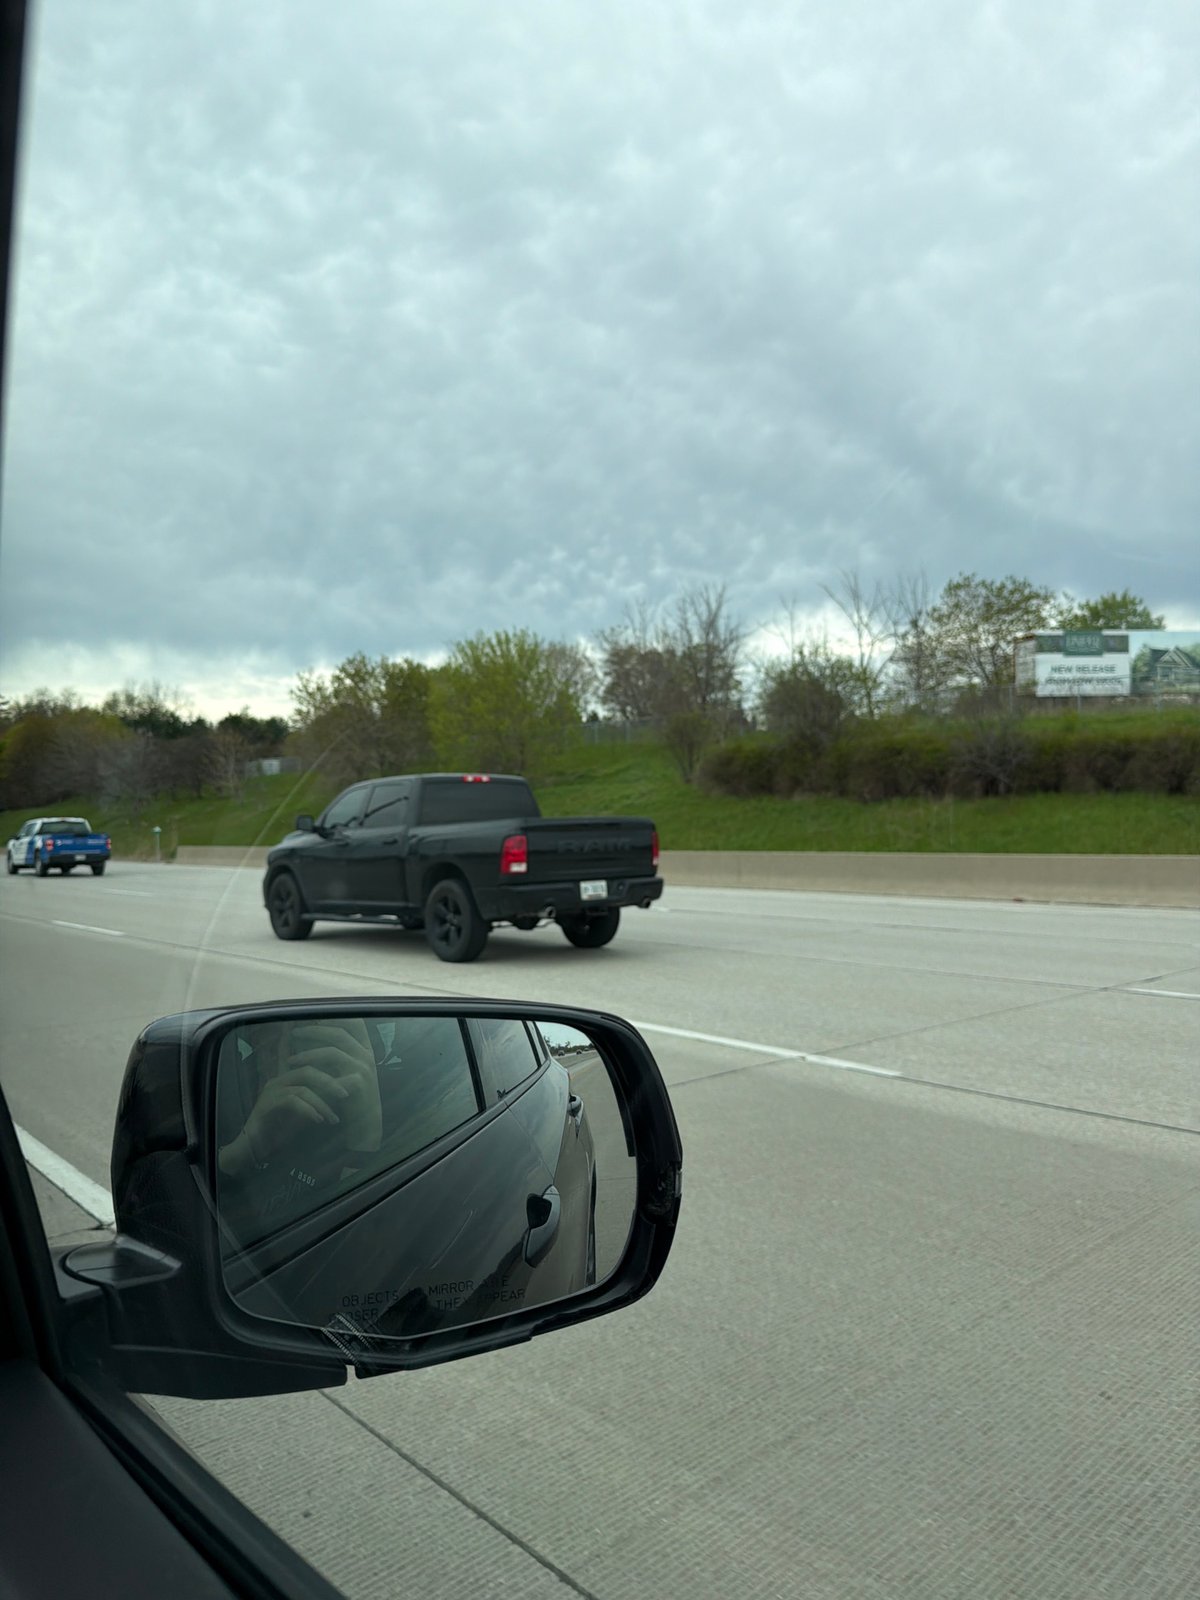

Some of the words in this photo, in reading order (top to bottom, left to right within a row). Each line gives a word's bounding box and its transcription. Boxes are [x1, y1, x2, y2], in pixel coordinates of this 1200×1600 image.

[1051, 664, 1073, 674] NEW
[1075, 664, 1117, 674] RELEASE
[342, 1290, 399, 1307] OBJECTS
[428, 1280, 474, 1296] MIRROR
